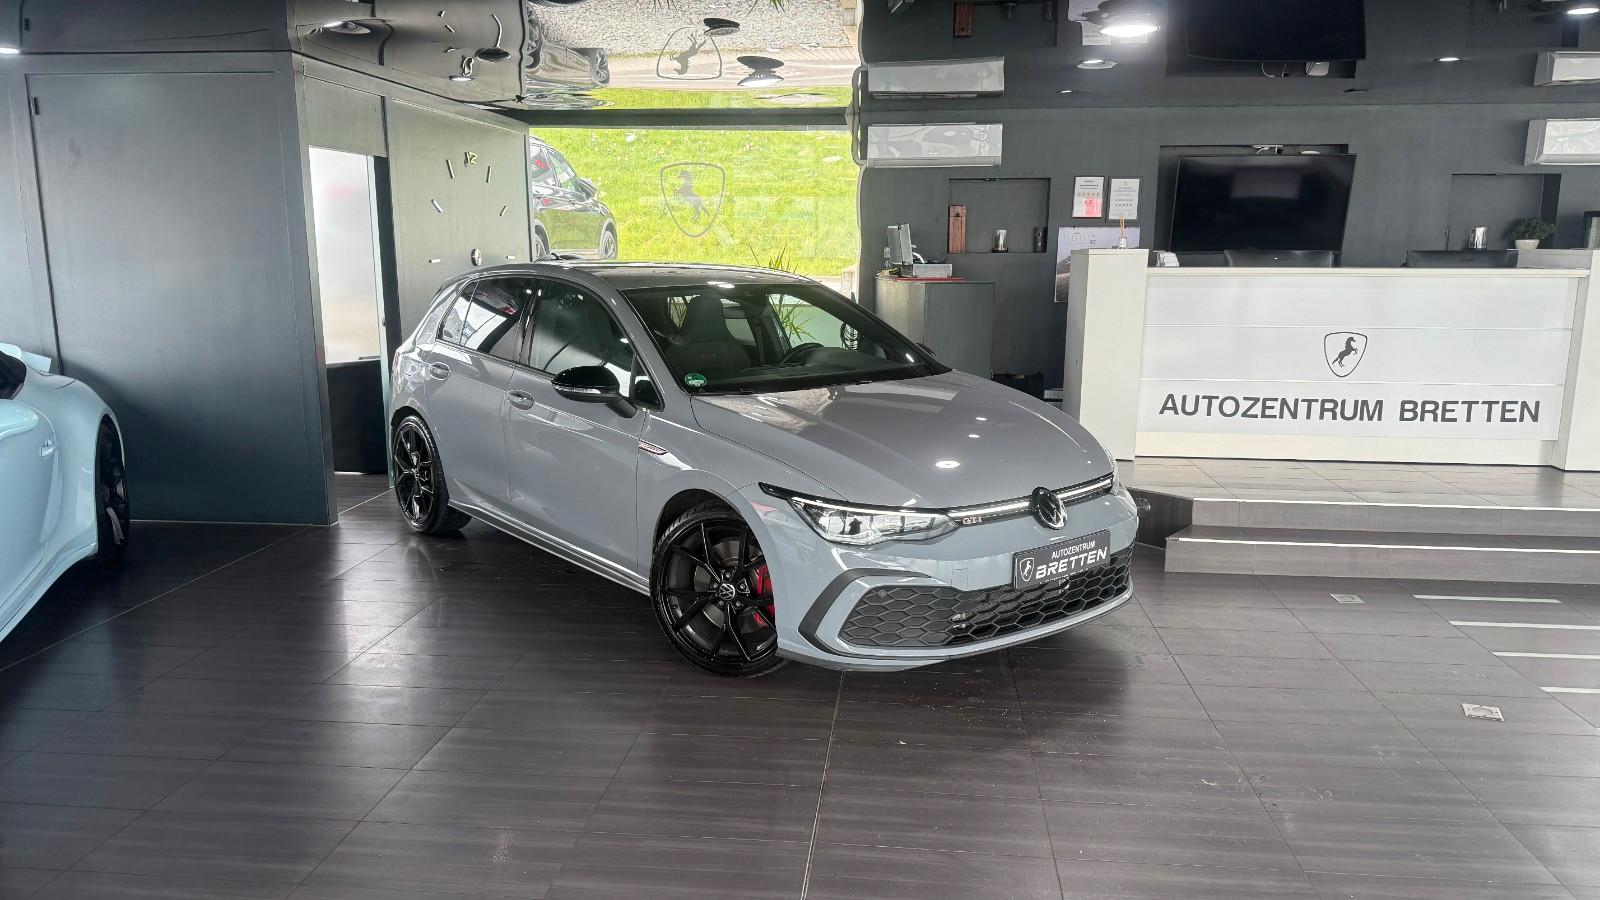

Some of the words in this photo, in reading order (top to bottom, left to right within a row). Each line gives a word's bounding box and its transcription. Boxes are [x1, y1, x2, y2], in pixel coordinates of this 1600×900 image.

[463, 151, 478, 164] 12
[1158, 393, 1384, 422] AUTOZENTRUM
[1399, 399, 1541, 423] BRETTEN
[962, 516, 983, 525] GTI
[1051, 540, 1096, 560] AUTOZENTRUM
[1035, 546, 1108, 580] BRETTEN
